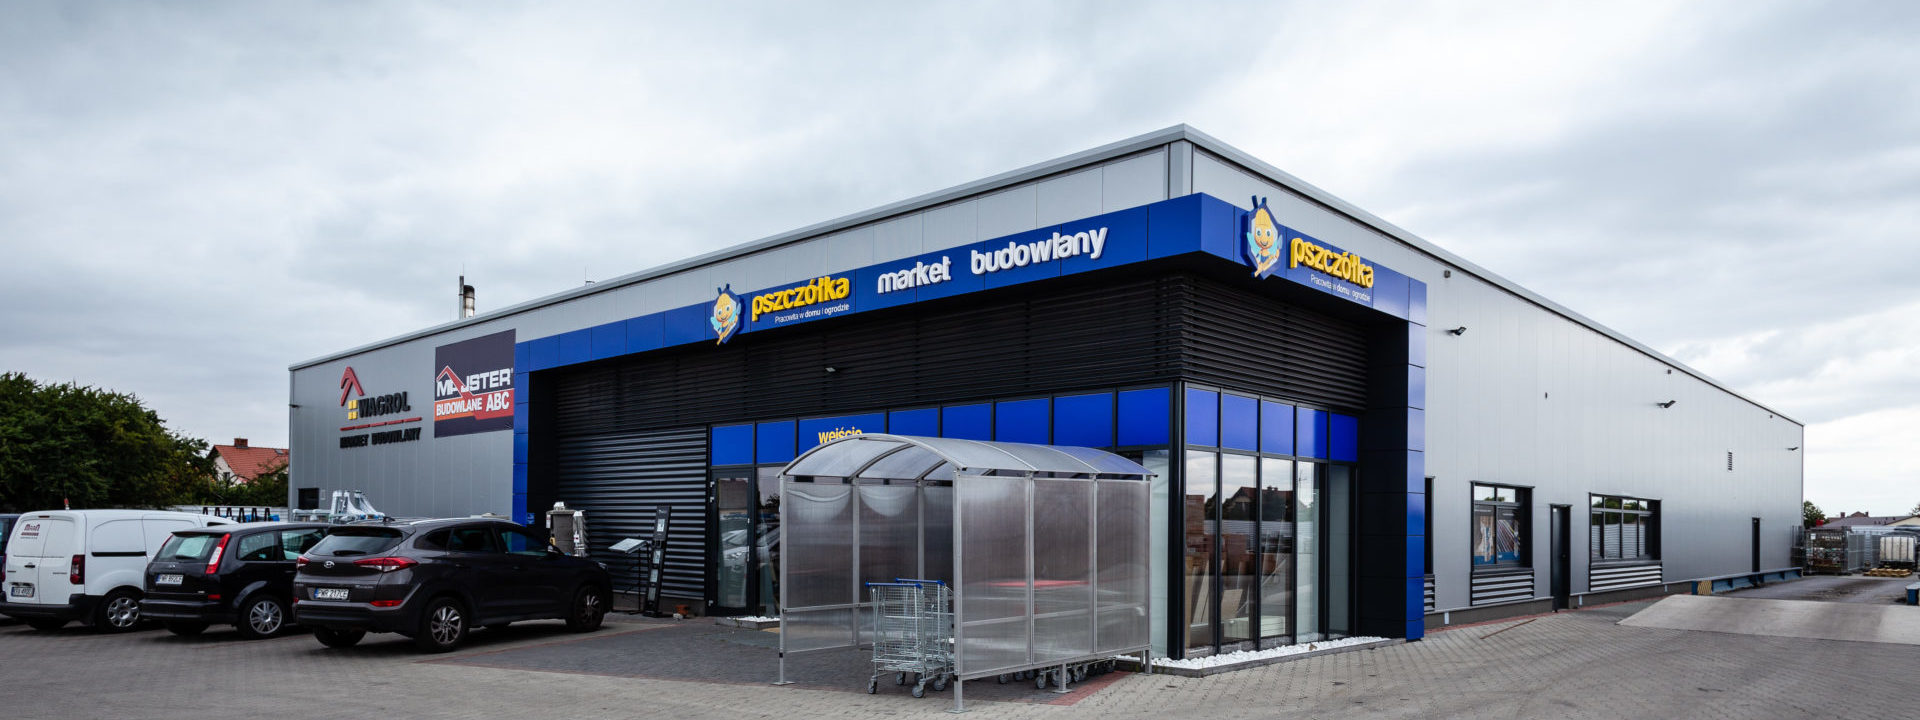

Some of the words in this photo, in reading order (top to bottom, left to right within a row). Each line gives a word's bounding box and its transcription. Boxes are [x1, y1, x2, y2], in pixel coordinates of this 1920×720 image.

[877, 255, 952, 294] market
[970, 226, 1109, 276] budowlany
[1290, 237, 1374, 288] pszczółka
[751, 275, 850, 322] pszczółka
[774, 313, 799, 324] Pracowita
[805, 307, 821, 318] domu
[824, 303, 850, 316] ogrodzie
[358, 391, 411, 418] WAGROL
[436, 397, 483, 416] BUDOWLANE
[485, 391, 510, 412] ABC
